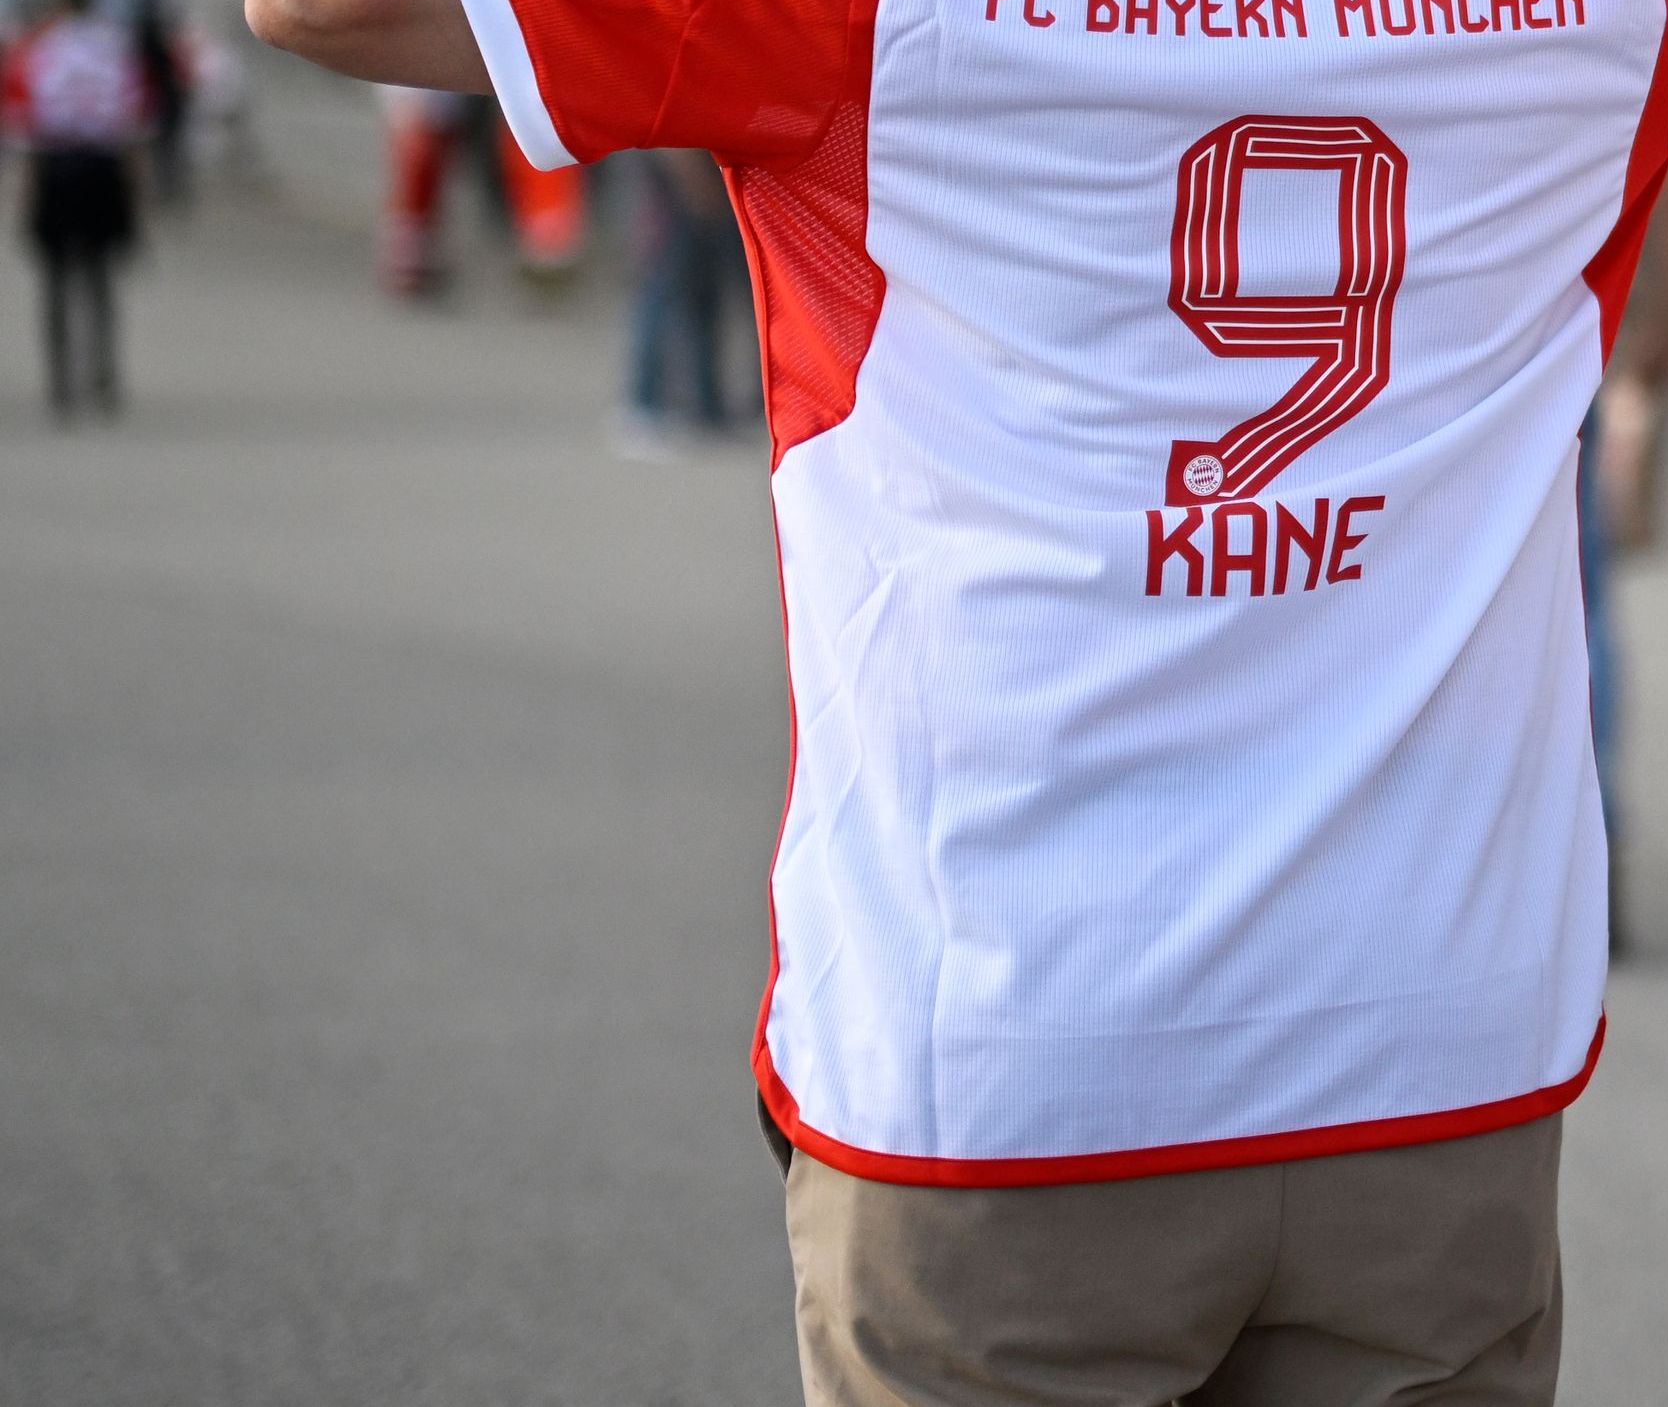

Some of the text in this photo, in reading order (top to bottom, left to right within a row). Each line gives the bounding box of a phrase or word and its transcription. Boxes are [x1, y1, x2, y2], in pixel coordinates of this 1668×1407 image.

[1164, 115, 1409, 507] 9
[1197, 458, 1220, 474] BAYERN
[1145, 495, 1386, 597] KANE
